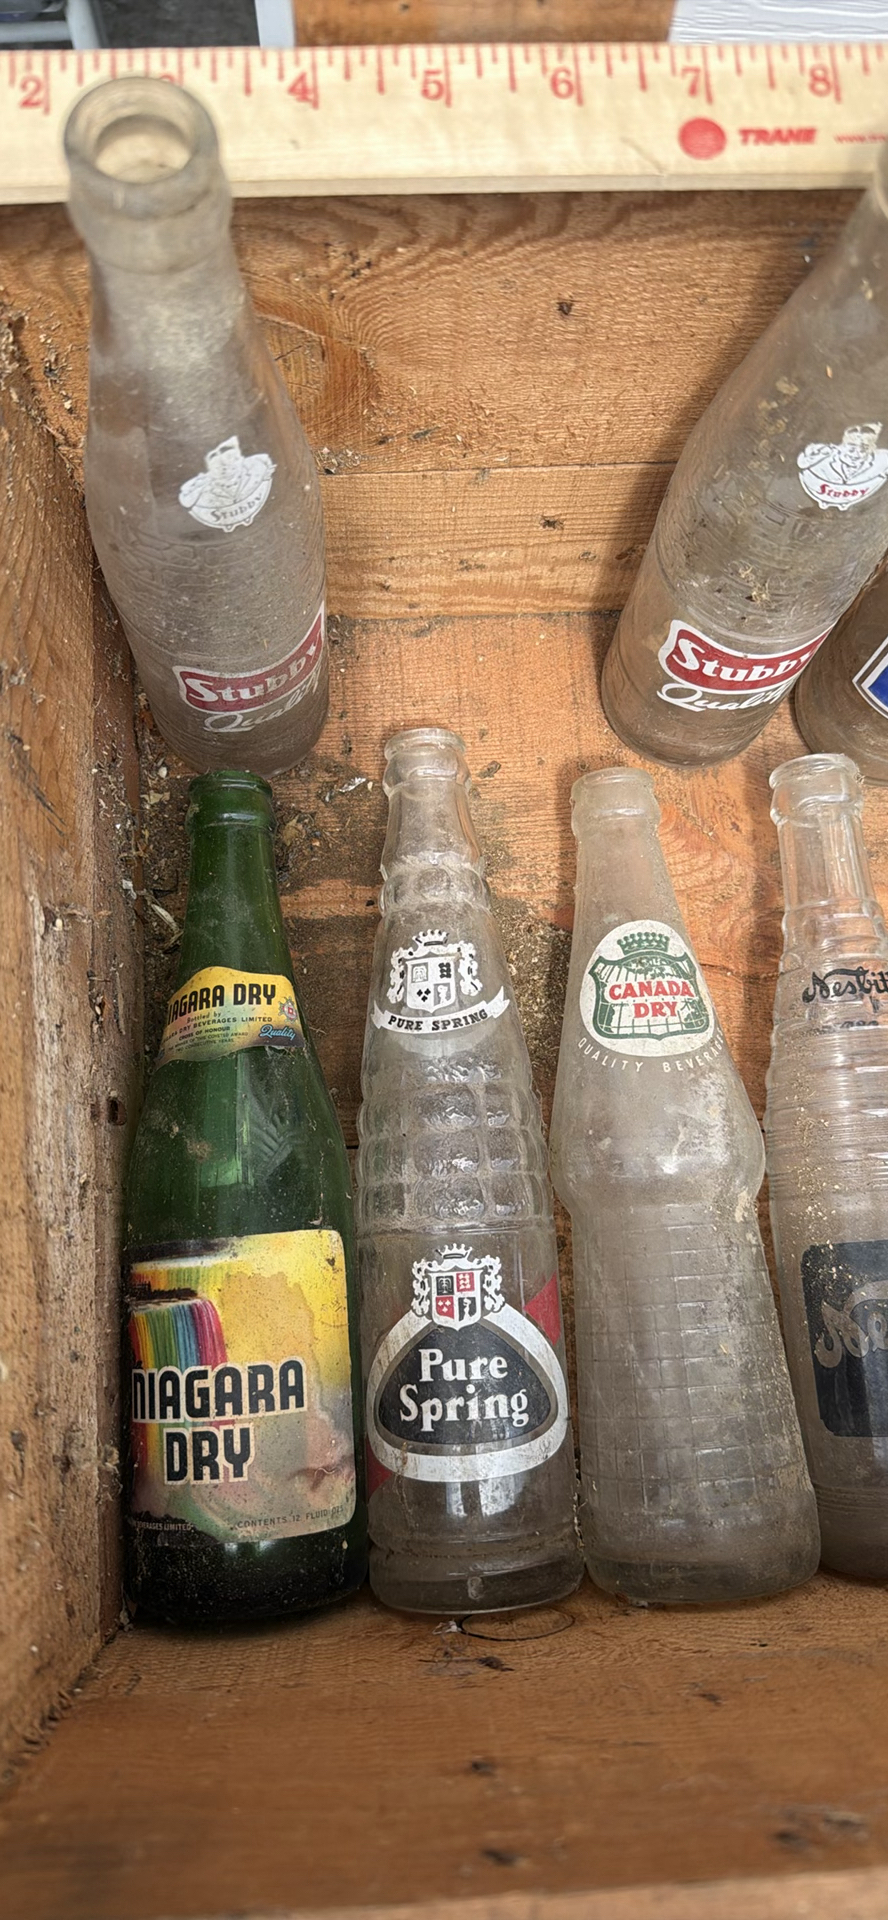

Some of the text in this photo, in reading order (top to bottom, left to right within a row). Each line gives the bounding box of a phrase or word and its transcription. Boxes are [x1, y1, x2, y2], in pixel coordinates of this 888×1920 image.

[19, 63, 831, 108] 2 4 5 6 7 8
[738, 127, 817, 146] TRANE
[185, 630, 322, 702] Stubby
[672, 638, 814, 682] Stubby
[609, 980, 695, 1001] CANADA
[801, 966, 888, 1004] Nesbit
[168, 983, 276, 1026] IAGARA DRY
[187, 1009, 222, 1024] Bottled by
[633, 1001, 679, 1019] DRY
[193, 1016, 237, 1028] BEVERAGES
[195, 1030, 203, 1038] OF
[204, 1026, 231, 1035] HONOUR
[258, 1024, 296, 1040] Quality
[388, 1008, 488, 1032] PURE SPRING
[577, 1037, 643, 1073] QUALITY
[418, 1348, 508, 1382] Pure
[133, 1358, 306, 1420] NIAGARA
[399, 1383, 530, 1432] Spring
[165, 1427, 252, 1482] DRY
[163, 1522, 192, 1532] LIMITED
[237, 1516, 287, 1529] CONTENTS
[292, 1514, 301, 1522] 12
[305, 1508, 328, 1520] FLUID
